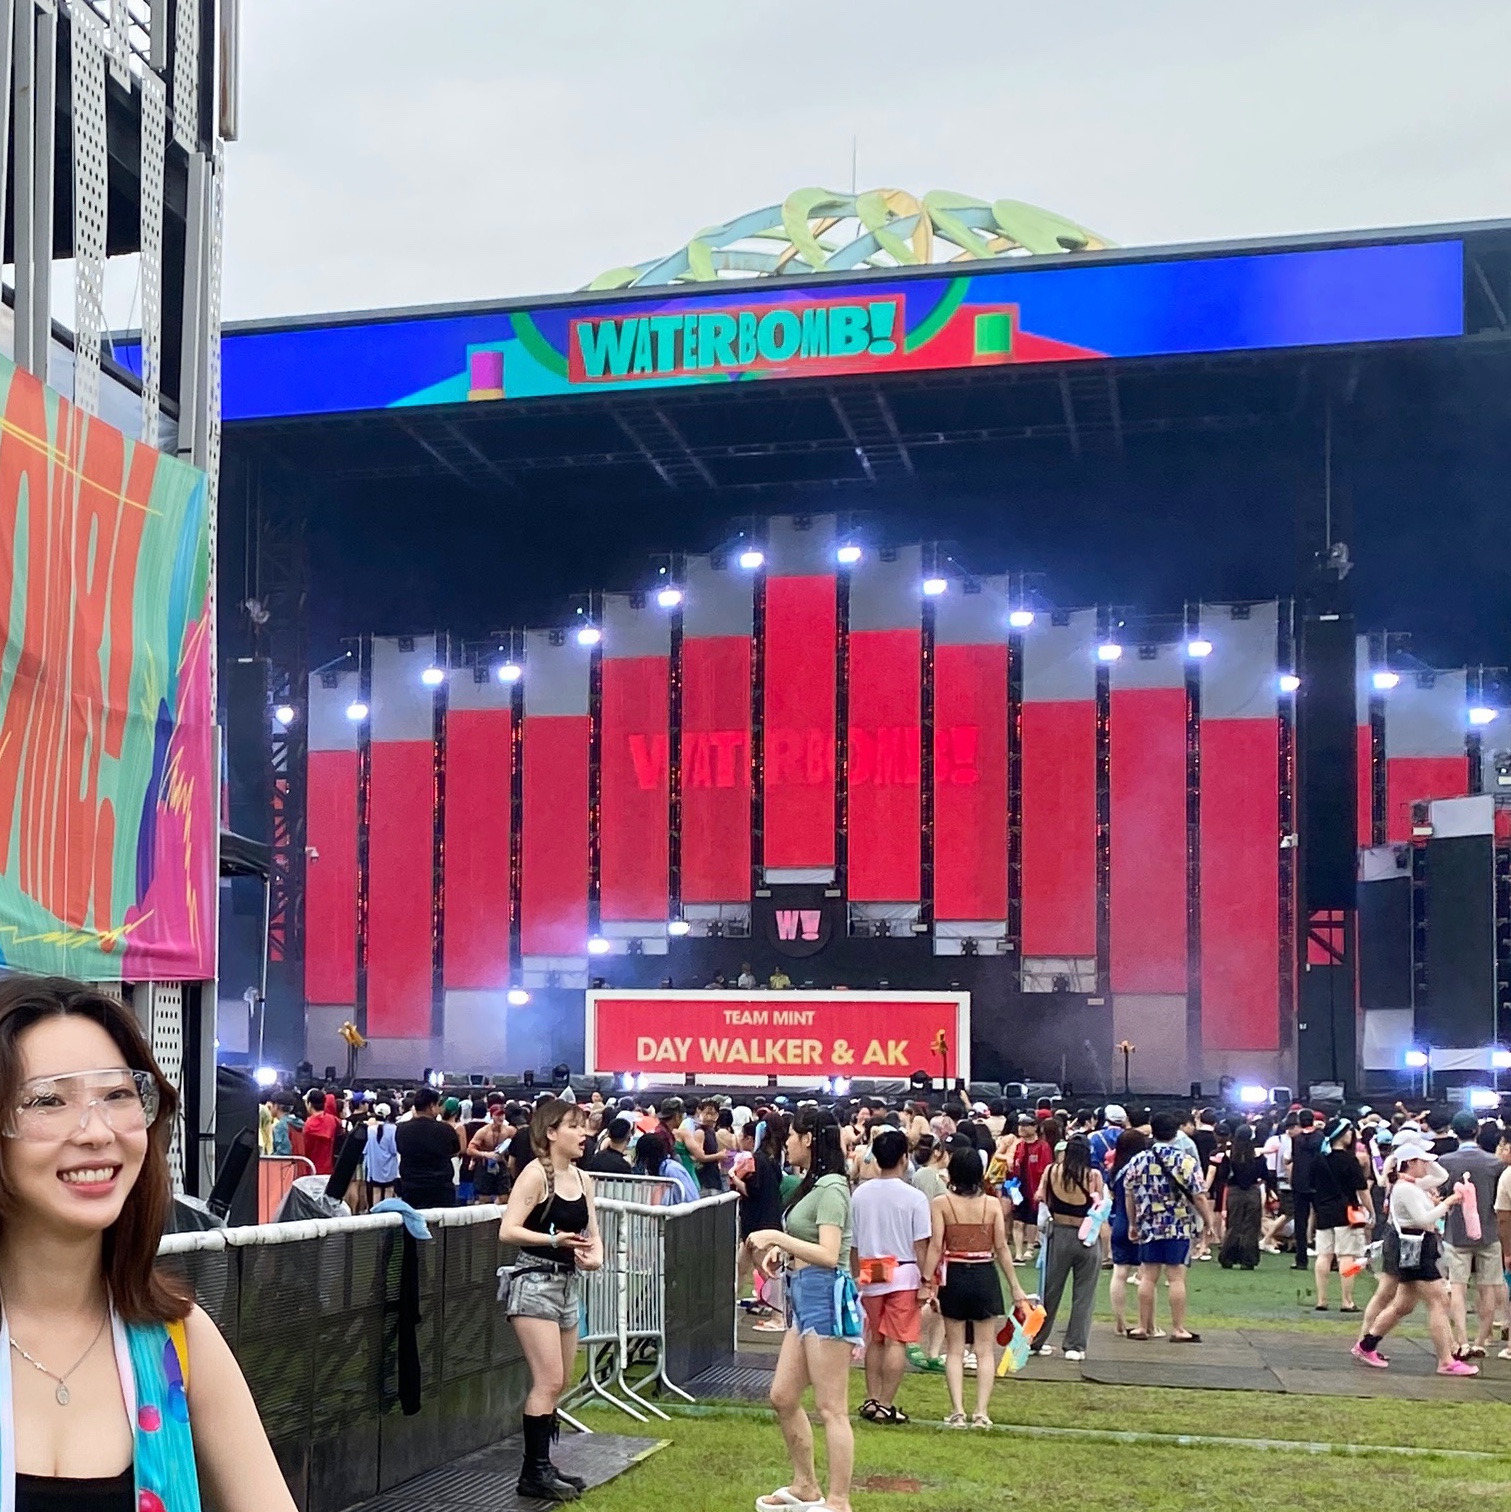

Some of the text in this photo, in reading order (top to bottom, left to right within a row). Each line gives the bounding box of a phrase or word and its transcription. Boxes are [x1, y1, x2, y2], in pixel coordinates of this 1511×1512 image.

[576, 301, 897, 378] WATERBOMB!
[723, 1010, 815, 1026] TEAM MINT
[637, 1037, 910, 1067] DAY WALKER & AK
